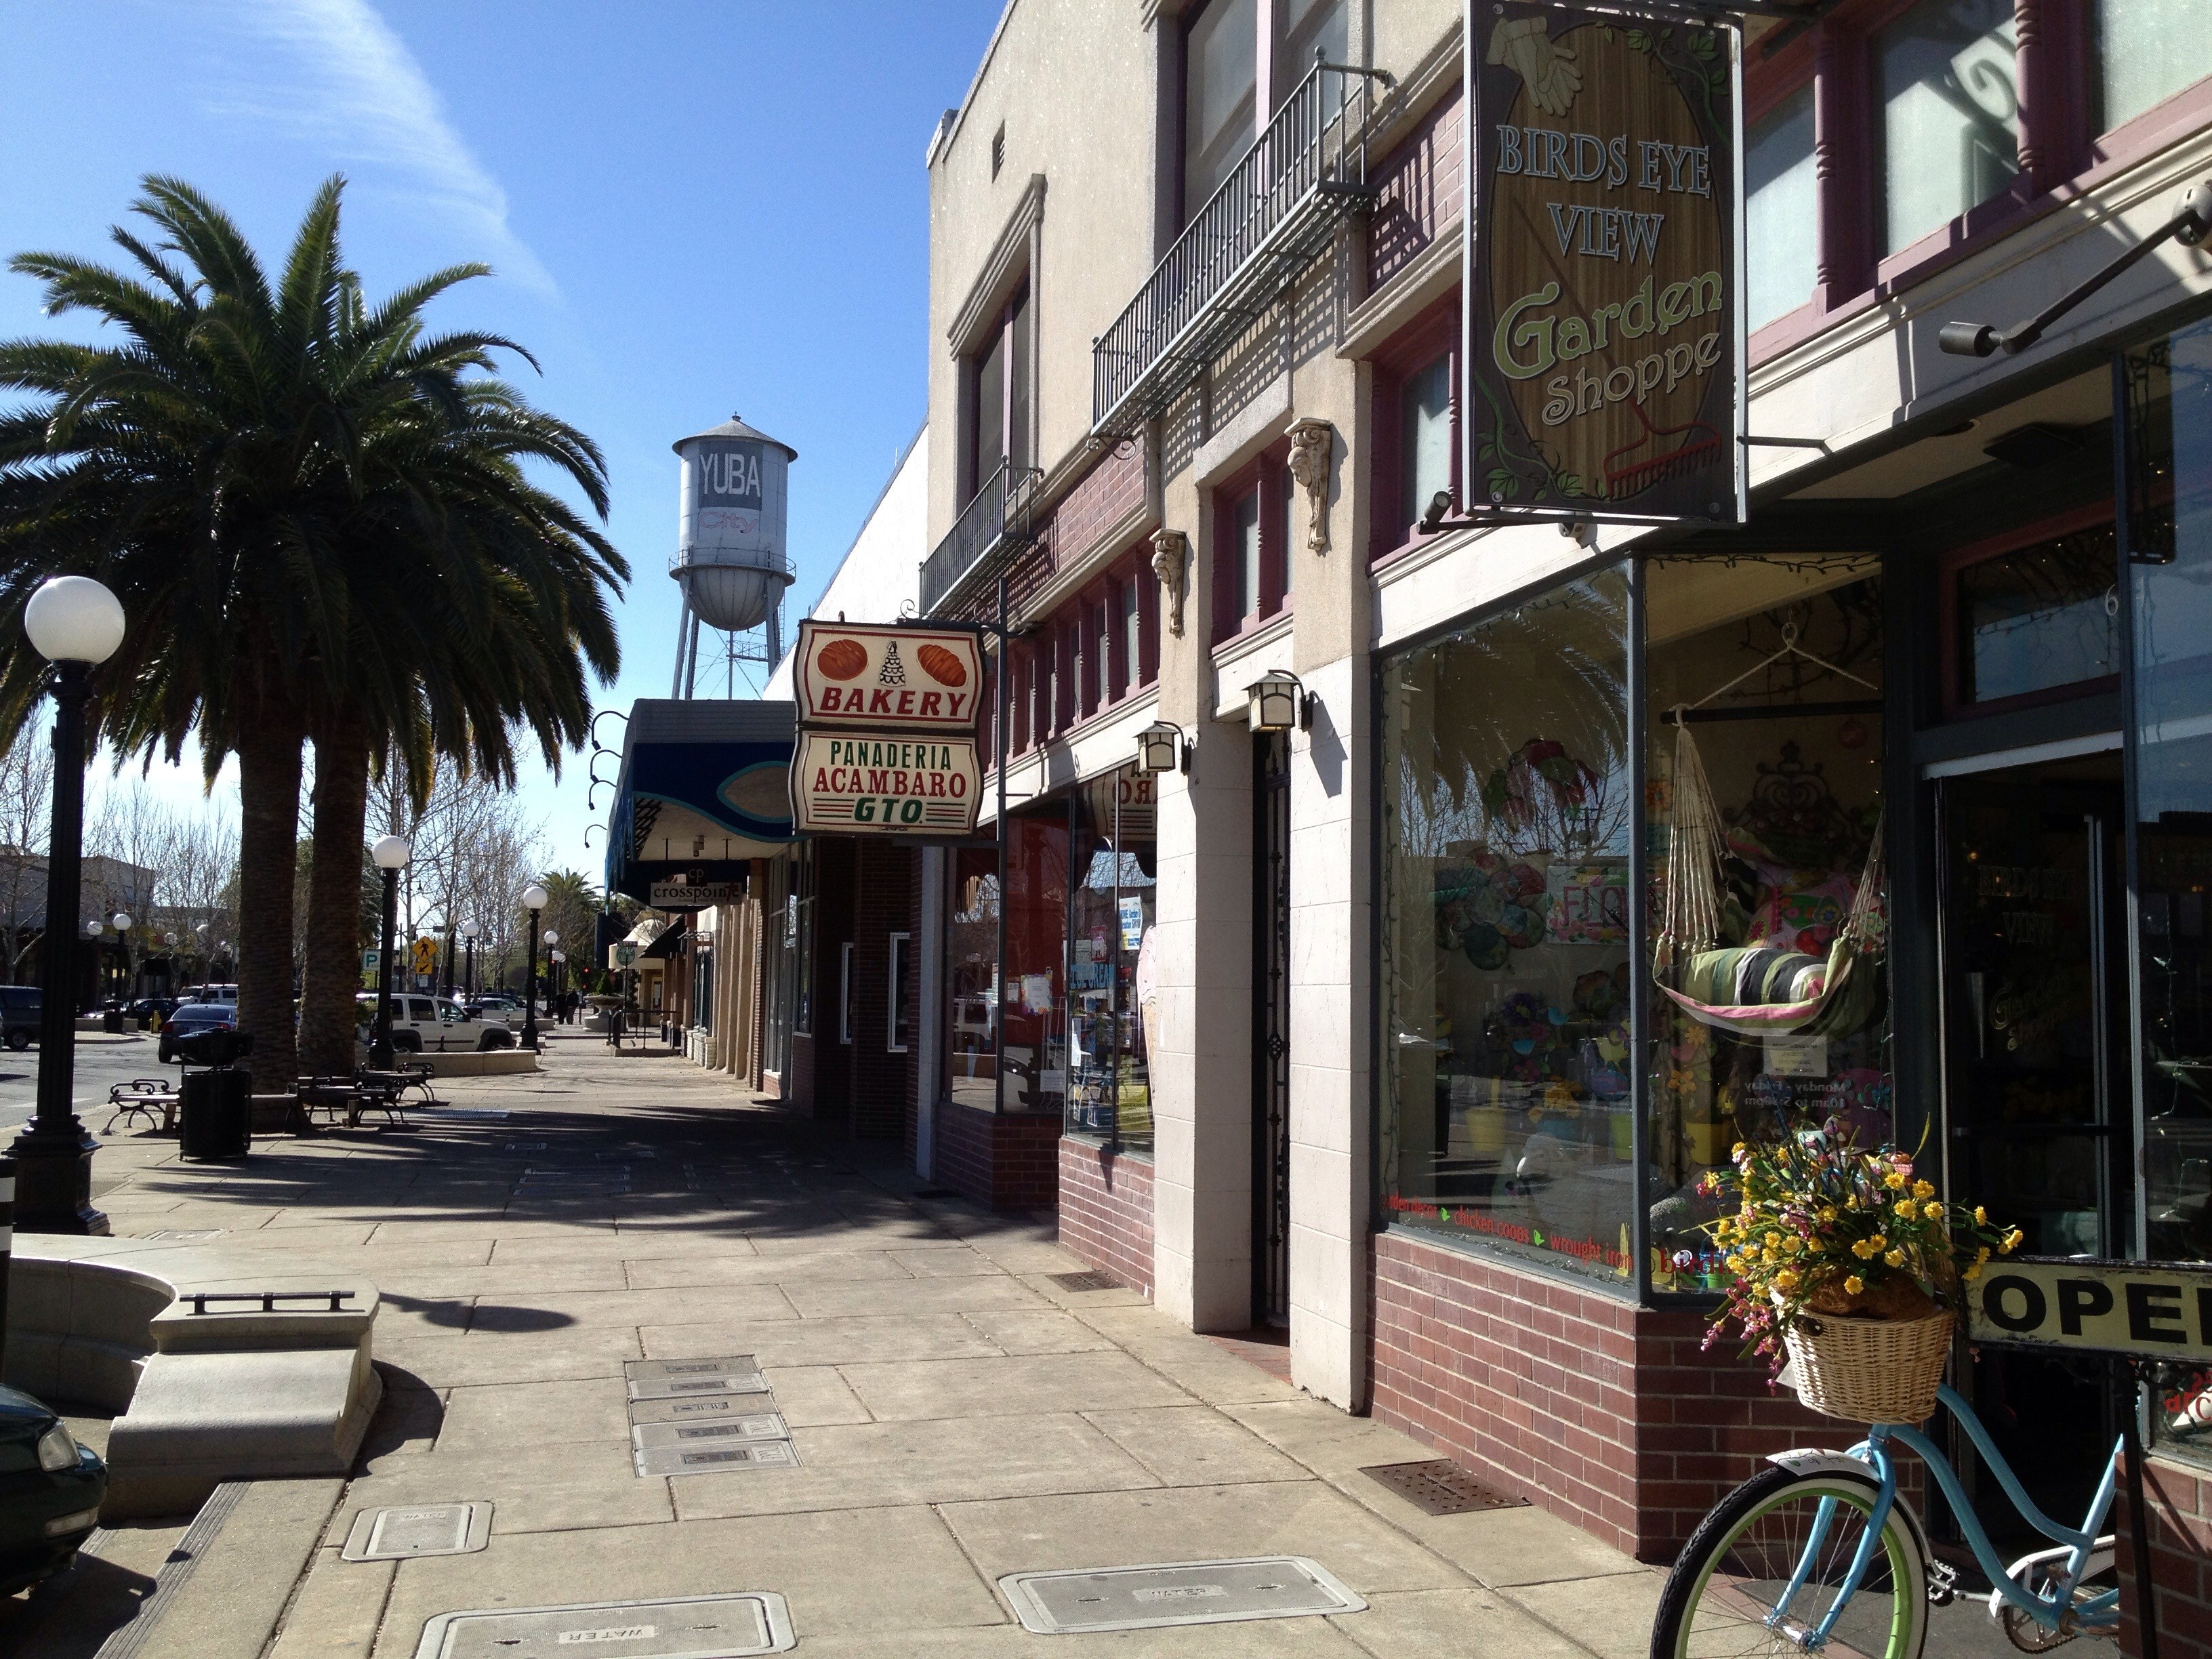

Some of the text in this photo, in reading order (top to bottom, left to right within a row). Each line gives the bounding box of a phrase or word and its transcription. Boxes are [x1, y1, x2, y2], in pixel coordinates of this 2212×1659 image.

[1496, 124, 1711, 199] BIRDS EYE
[1547, 203, 1664, 266] VIEW
[1492, 271, 1723, 380] Garden
[1542, 331, 1721, 426] Shoppe
[699, 453, 762, 498] YUBA
[699, 510, 759, 535] City
[820, 687, 968, 718] BAKERY
[831, 741, 951, 771] PANADERIA
[813, 767, 967, 800] ACAMBARO
[688, 868, 704, 883] cp
[366, 954, 377, 968] P
[1551, 1235, 1602, 1266] wrought
[1982, 1274, 2212, 1347] OPE
[1147, 1587, 1207, 1598] WATER
[569, 1629, 643, 1641] WATER
